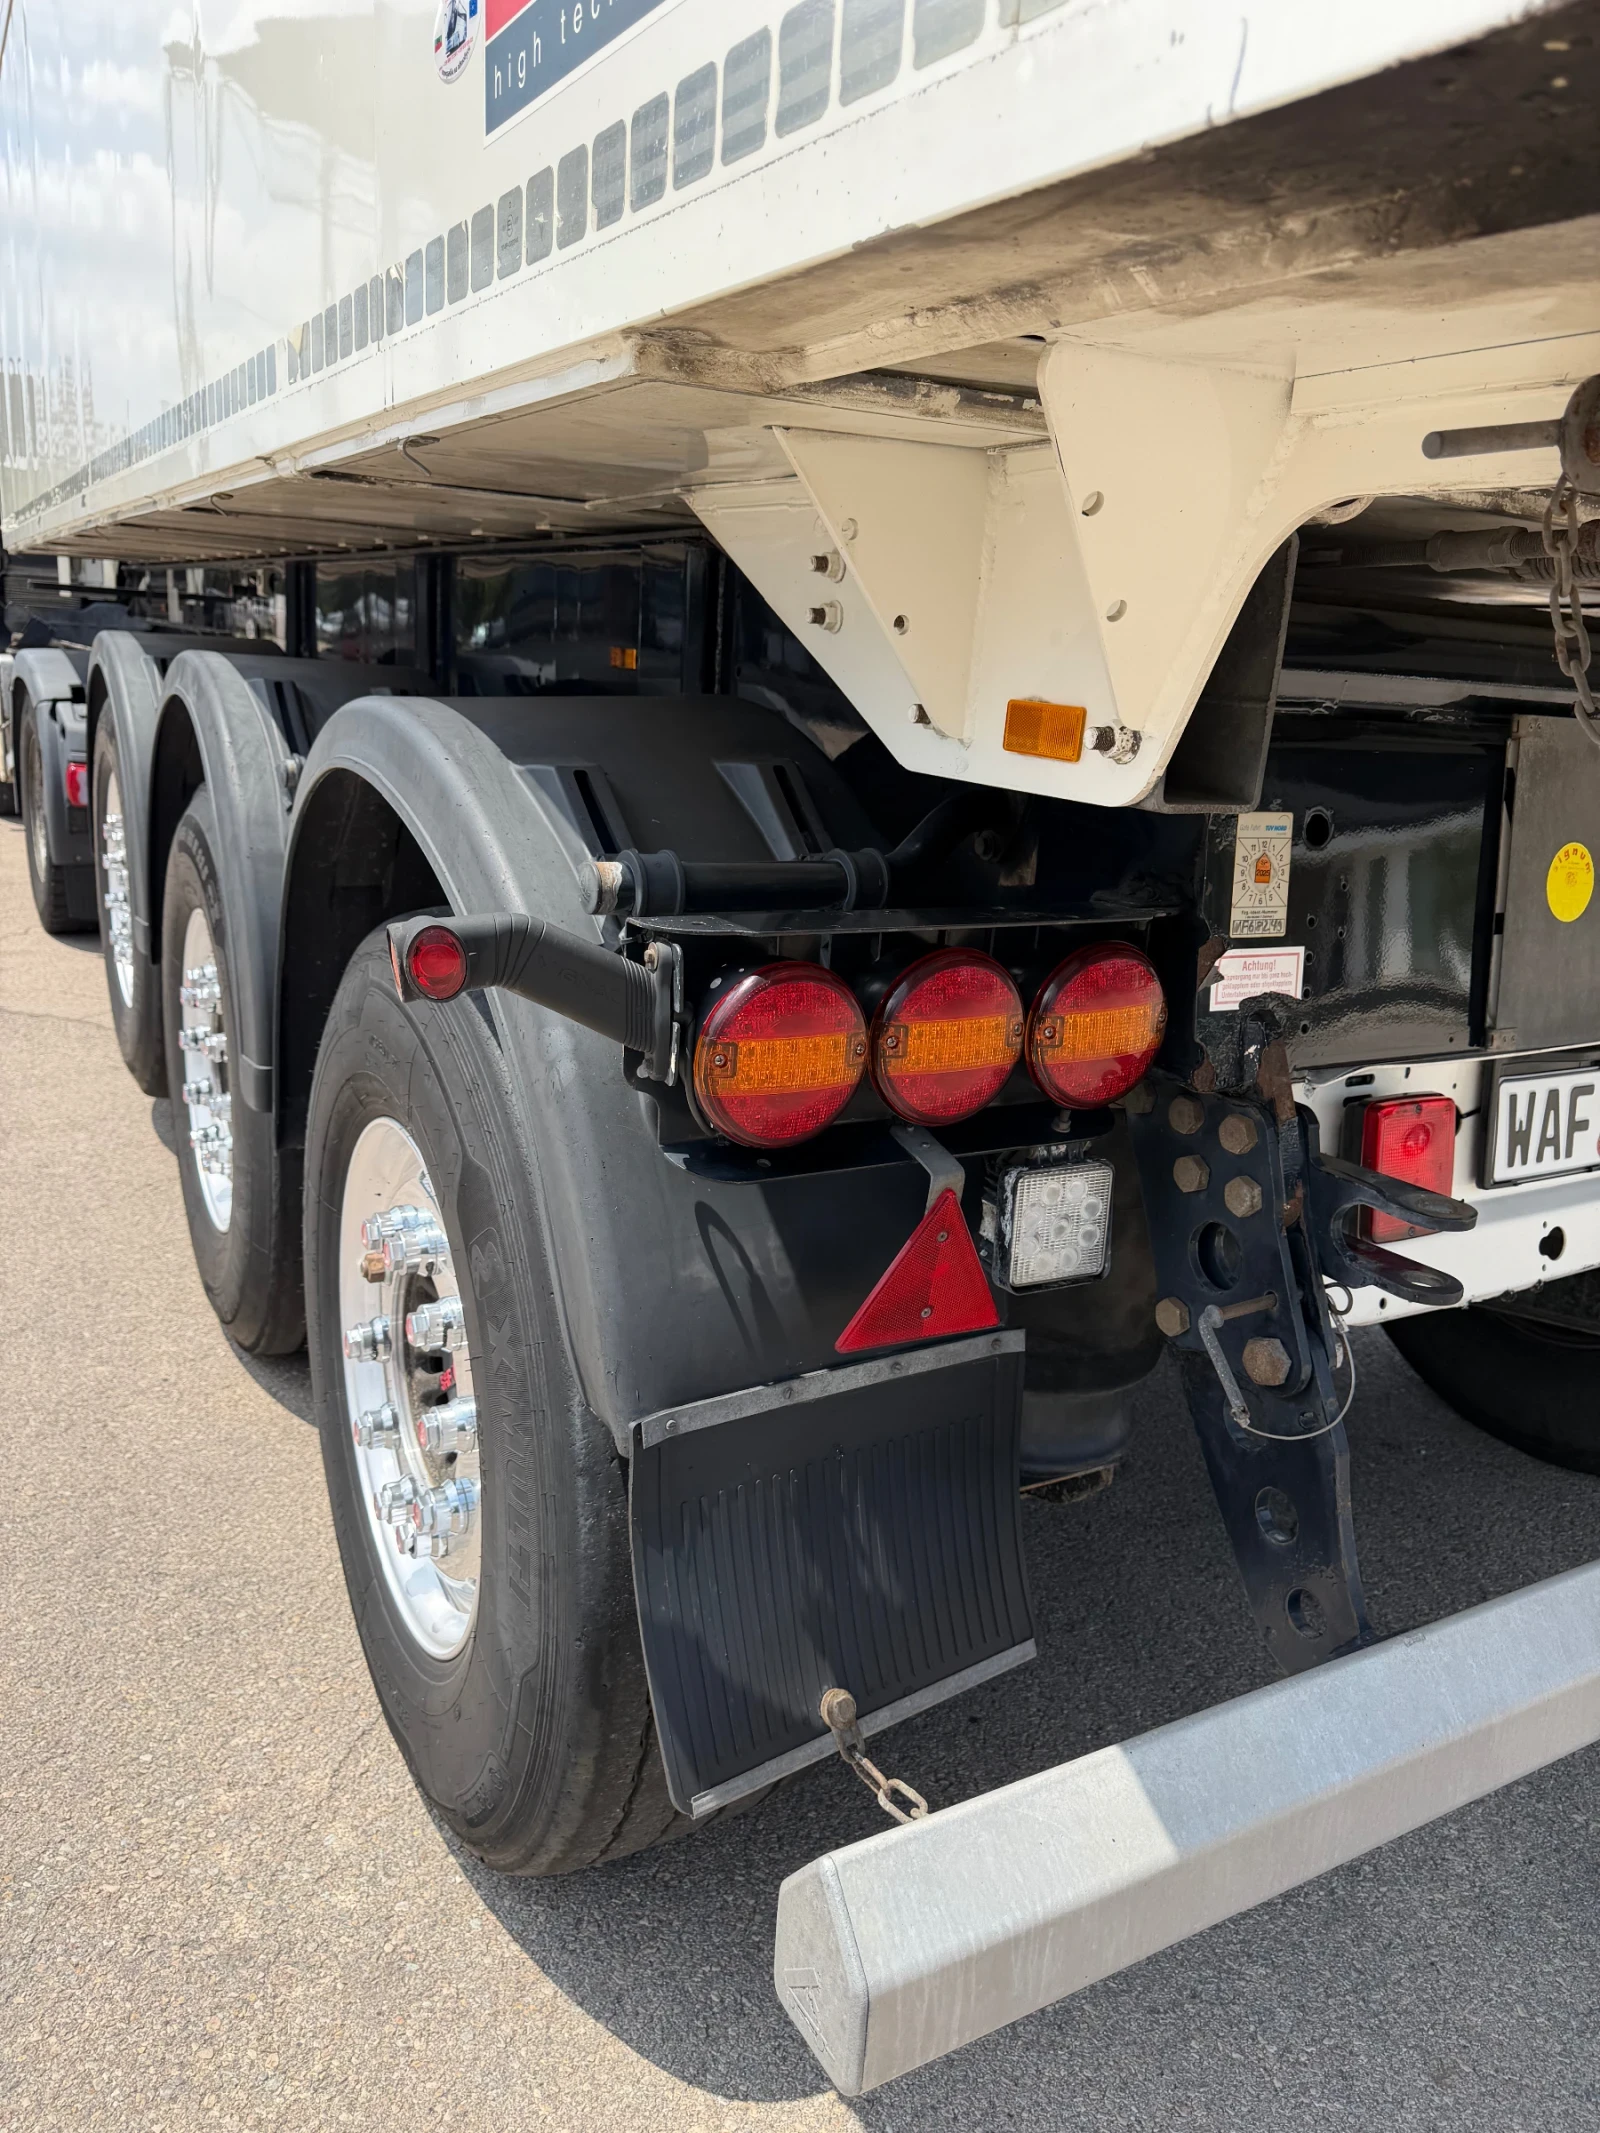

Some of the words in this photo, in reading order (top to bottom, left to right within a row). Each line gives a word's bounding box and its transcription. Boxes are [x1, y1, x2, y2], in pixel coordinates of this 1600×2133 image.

[494, 31, 541, 99] high
[560, 0, 619, 44] tec
[1242, 959, 1276, 972] Achtung!
[1507, 1084, 1595, 1168] WAF
[496, 1391, 531, 1611] MULTI
